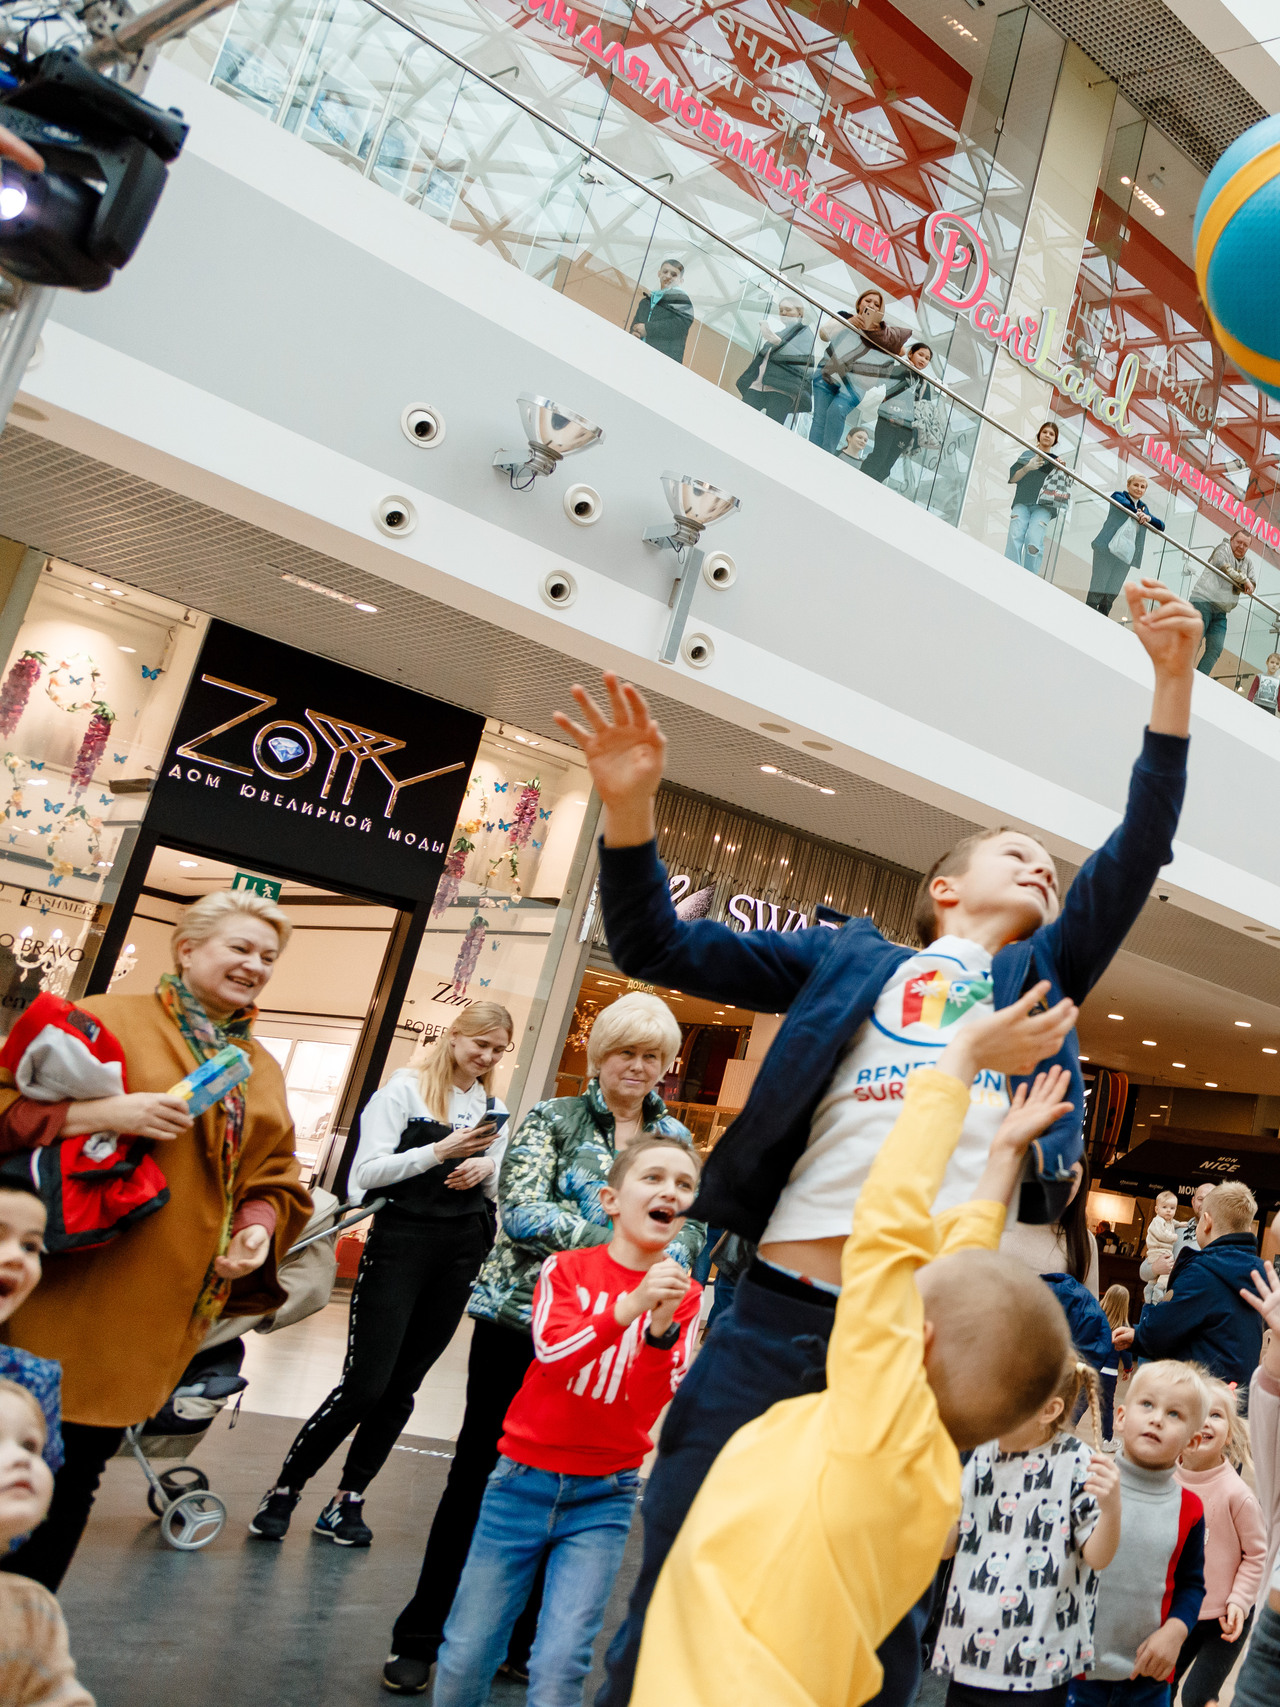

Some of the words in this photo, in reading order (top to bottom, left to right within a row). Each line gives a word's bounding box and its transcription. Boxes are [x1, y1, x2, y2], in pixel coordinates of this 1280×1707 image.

[577, 25, 649, 93] ДЛЯ
[645, 77, 811, 207] ЛЮБИМЫХ
[807, 193, 891, 266] ДЕТЕЙ
[1144, 435, 1225, 508] МАГАЗИН
[1221, 494, 1257, 531] ДЛЯ
[168, 764, 221, 789] ДОМ
[239, 783, 373, 833] ЮВЕЛИРНОЙ
[387, 827, 445, 854] МОДЫ
[728, 893, 840, 934] SWA
[21, 938, 85, 962] BRAVO
[1199, 1160, 1242, 1173] NICE
[1217, 1156, 1239, 1164] MON
